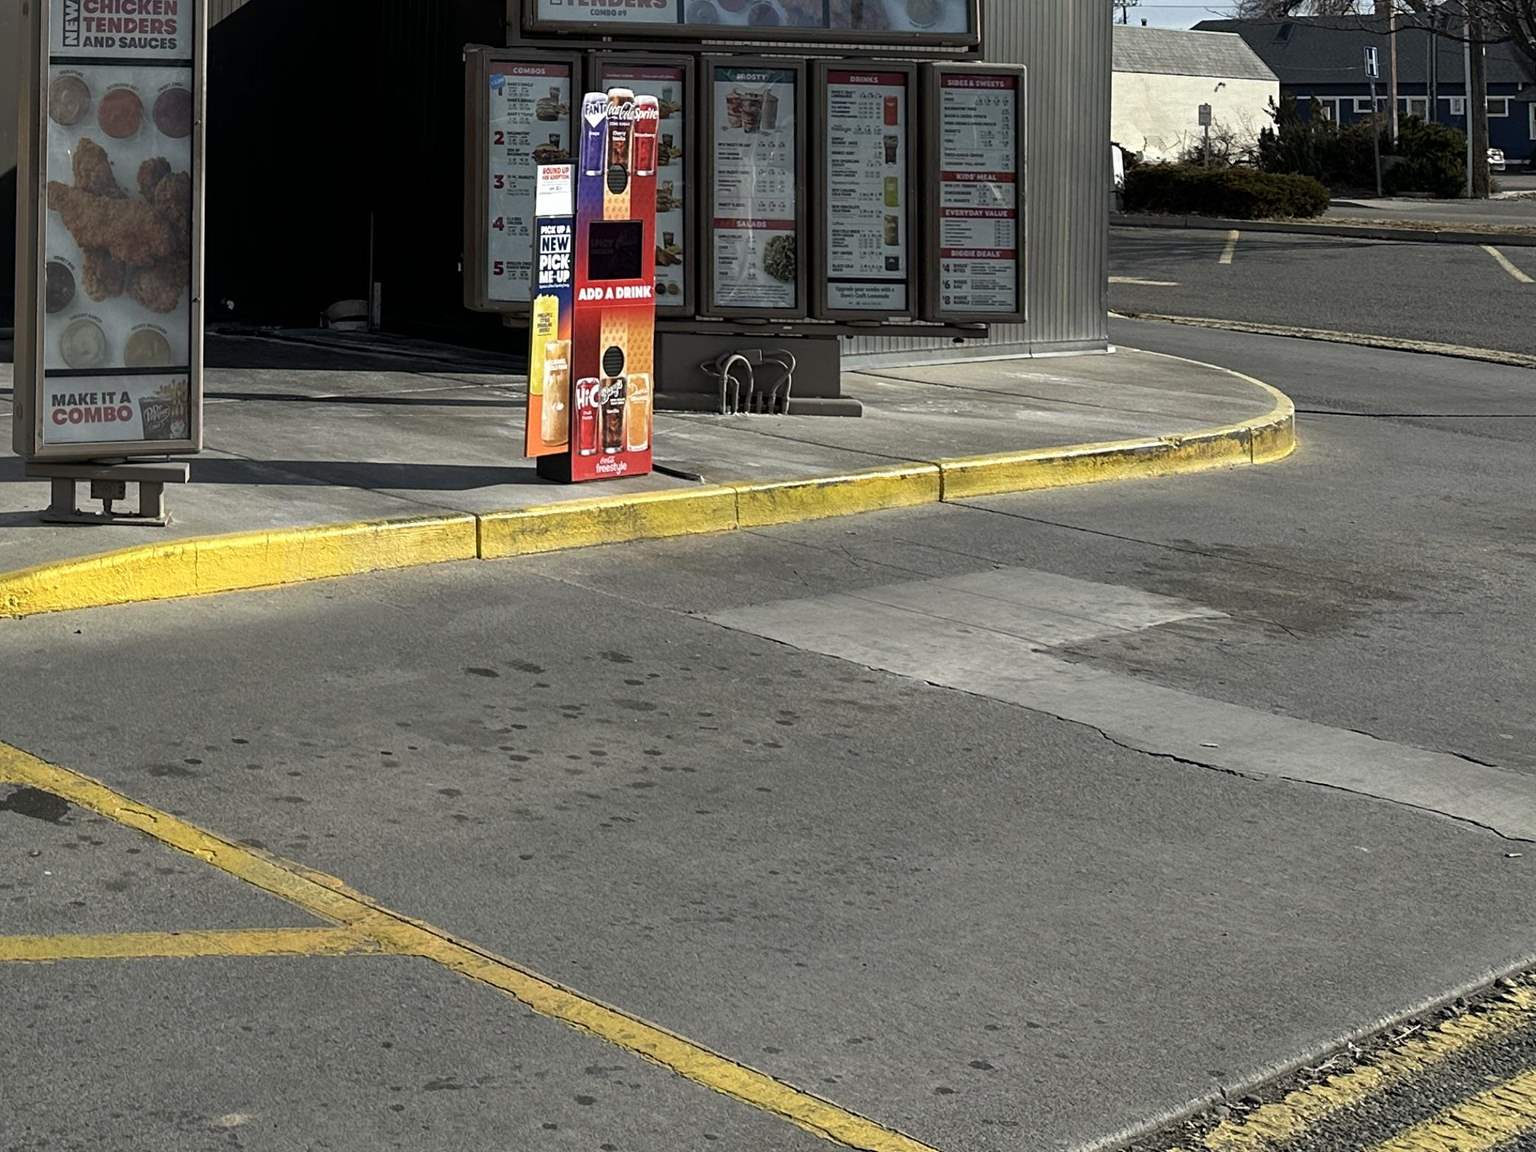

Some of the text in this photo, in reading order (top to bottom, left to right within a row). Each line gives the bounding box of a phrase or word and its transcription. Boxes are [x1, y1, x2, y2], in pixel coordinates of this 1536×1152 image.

[590, 8, 627, 17] COMBO #9
[84, 16, 177, 35] TENDERS
[83, 36, 177, 49] AND SAUCES
[585, 102, 607, 115] FANT
[635, 107, 658, 121] Sprite
[494, 131, 504, 145] 2
[493, 175, 504, 189] 3
[493, 217, 504, 231] 4
[541, 225, 571, 234] PICK UP A
[542, 236, 569, 251] NEW
[493, 261, 504, 275] 5
[539, 254, 570, 270] PICK-
[539, 270, 570, 284] ME-UP
[578, 285, 652, 300] ADD A DRINK
[52, 391, 131, 407] MAKE IT A
[52, 405, 133, 426] COMBO
[595, 460, 627, 476] freestyle
